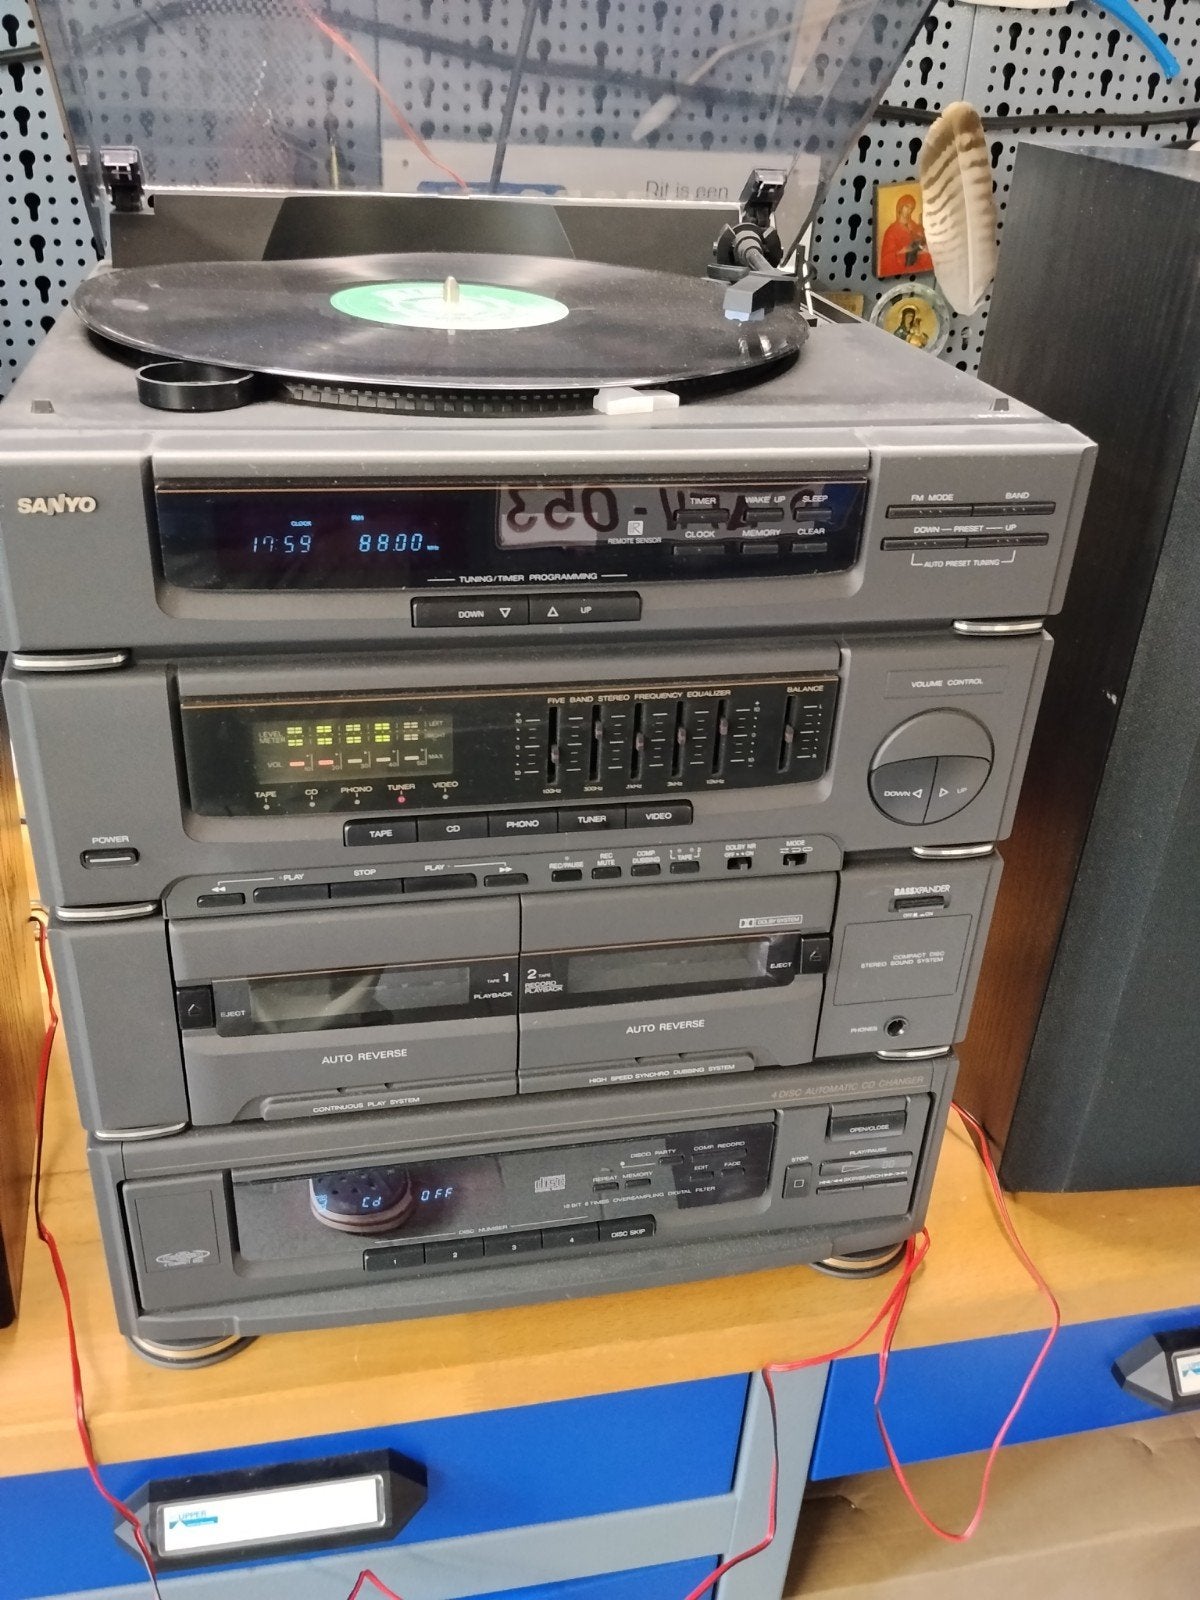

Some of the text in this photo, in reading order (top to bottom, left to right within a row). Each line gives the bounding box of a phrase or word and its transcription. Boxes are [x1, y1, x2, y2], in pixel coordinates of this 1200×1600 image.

[676, 185, 690, 199] is
[745, 495, 786, 503] WAKE UP
[802, 494, 829, 503] SLEEP
[928, 493, 954, 501] MODE
[1005, 491, 1030, 500] BAND
[17, 493, 97, 516] SANYO
[690, 497, 717, 505] TIMER
[741, 528, 781, 537] MEMORY
[797, 527, 826, 535] CLEAR
[913, 523, 1017, 534] DOWN PRESET UP
[684, 530, 715, 538] CLOCK
[252, 535, 312, 553] 17:59
[359, 533, 423, 552] 88.00
[608, 536, 661, 545] REMOTE SENSOR
[923, 558, 1000, 568] AUTO PRESET TUNING
[458, 572, 598, 584] TUNING/TIMER PROGRAMMING
[458, 610, 484, 619] DOWN
[580, 606, 592, 614] UP
[911, 678, 983, 688] VOLUME CONTROL
[787, 685, 824, 693] BALANCE
[598, 694, 630, 702] STEREO
[634, 691, 683, 700] FREQUENCY
[687, 689, 731, 698] EQUALIZER
[258, 736, 285, 745] METER
[387, 783, 416, 791] TUNER
[432, 780, 459, 788] VIDEO
[304, 788, 318, 796] CD
[340, 785, 373, 793] PHONO
[956, 786, 968, 794] UP
[254, 790, 277, 798] TAPE
[577, 814, 607, 824] TUNER
[645, 811, 672, 821] VIDEO
[506, 819, 539, 828] PHONO
[446, 824, 461, 833] CD
[369, 829, 393, 839] TAPE
[92, 835, 129, 844] POWER
[632, 856, 661, 864] DUBBING
[677, 853, 693, 861] TAPE
[548, 861, 584, 869] REC/PAUSE
[597, 858, 615, 866] MUTE
[353, 868, 377, 877] STOP
[424, 864, 445, 872] PLAY
[283, 873, 305, 881] PLAY
[893, 952, 926, 960] COMPACT
[861, 961, 887, 969] STEREO
[502, 972, 510, 983] 1
[527, 969, 537, 980] 2
[525, 980, 557, 989] RECORD
[525, 986, 563, 995] PLAYBACK
[473, 991, 513, 1000] PLAYBACK
[220, 1010, 246, 1018] EJECT
[626, 1019, 706, 1035] AUTO REVERSE
[850, 1025, 878, 1034] PHONES
[321, 1048, 408, 1065] AUTO REVERSE
[589, 1063, 735, 1084] HIGH SPEED SYNCHRO DUBBING SYSTEM
[771, 1075, 925, 1099] 4 DISC AUTOMATIC CD CHANGER
[312, 1096, 421, 1113] CONTINUOUS PLAY SYSTEM
[849, 1123, 890, 1133] OPEN/CLOSE
[717, 1140, 746, 1149] RECORD
[630, 1148, 677, 1159] DISCO PARTY
[694, 1163, 709, 1171] EDIT
[723, 1160, 742, 1168] FADE
[592, 1174, 618, 1183] REPEAT
[622, 1170, 654, 1179] MEMORY
[361, 1187, 454, 1208] Cd OFF
[590, 1197, 610, 1206] TIMES
[613, 1191, 664, 1203] OVERSAMPLING
[667, 1188, 692, 1197] DIGITAL
[695, 1186, 716, 1194] FILTER
[458, 1224, 508, 1236] DISC NUMBER
[611, 1228, 646, 1238] DISC SKIP
[569, 1236, 575, 1244] 4
[511, 1243, 517, 1251] 3
